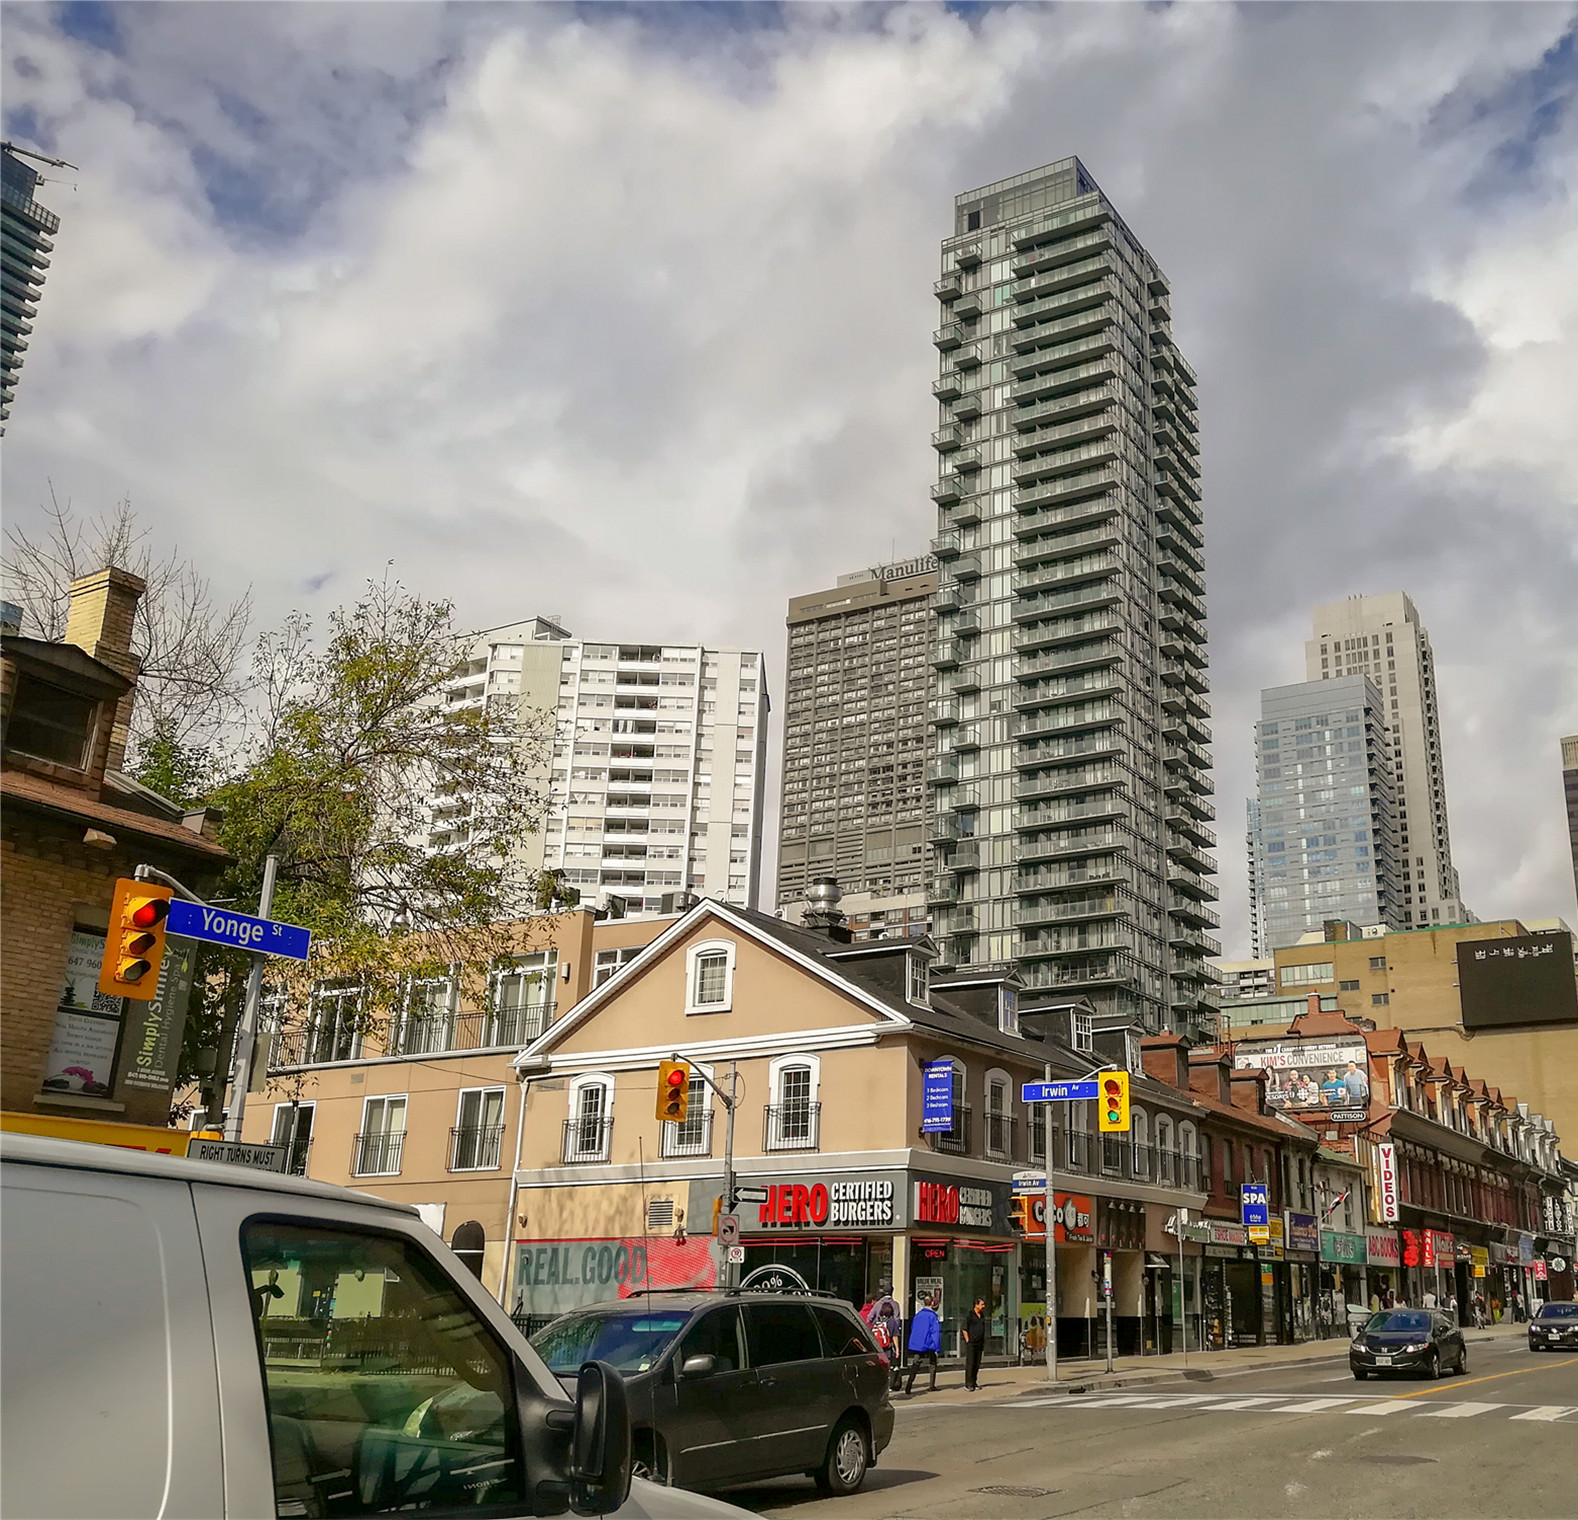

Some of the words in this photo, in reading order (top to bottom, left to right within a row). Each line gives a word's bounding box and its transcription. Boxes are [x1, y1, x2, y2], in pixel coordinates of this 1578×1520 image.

[871, 556, 939, 580] Manulife
[202, 908, 264, 945] Yonge
[272, 924, 283, 937] St
[71, 932, 105, 950] SimplyS
[68, 956, 84, 966] 647
[154, 1032, 168, 1068] Dental
[162, 980, 177, 1030] Hygiene
[1260, 1055, 1286, 1068] KIM'S
[1286, 1051, 1344, 1066] CONVENIENCE
[1042, 1085, 1068, 1098] Irwin
[200, 1145, 224, 1161] RIGHT
[227, 1147, 251, 1164] TURNS
[253, 1151, 275, 1166] MUST
[1381, 1147, 1395, 1218] VIDEOS
[759, 1182, 829, 1223] HERO
[831, 1180, 893, 1201] CERTIFIED
[914, 1181, 960, 1224] HERO
[1243, 1192, 1267, 1205] SPA
[831, 1200, 893, 1222] BURGERS
[925, 1249, 945, 1259] OPEN
[1424, 1229, 1432, 1265] NAILS
[518, 1245, 655, 1286] REAL.GOOD.
